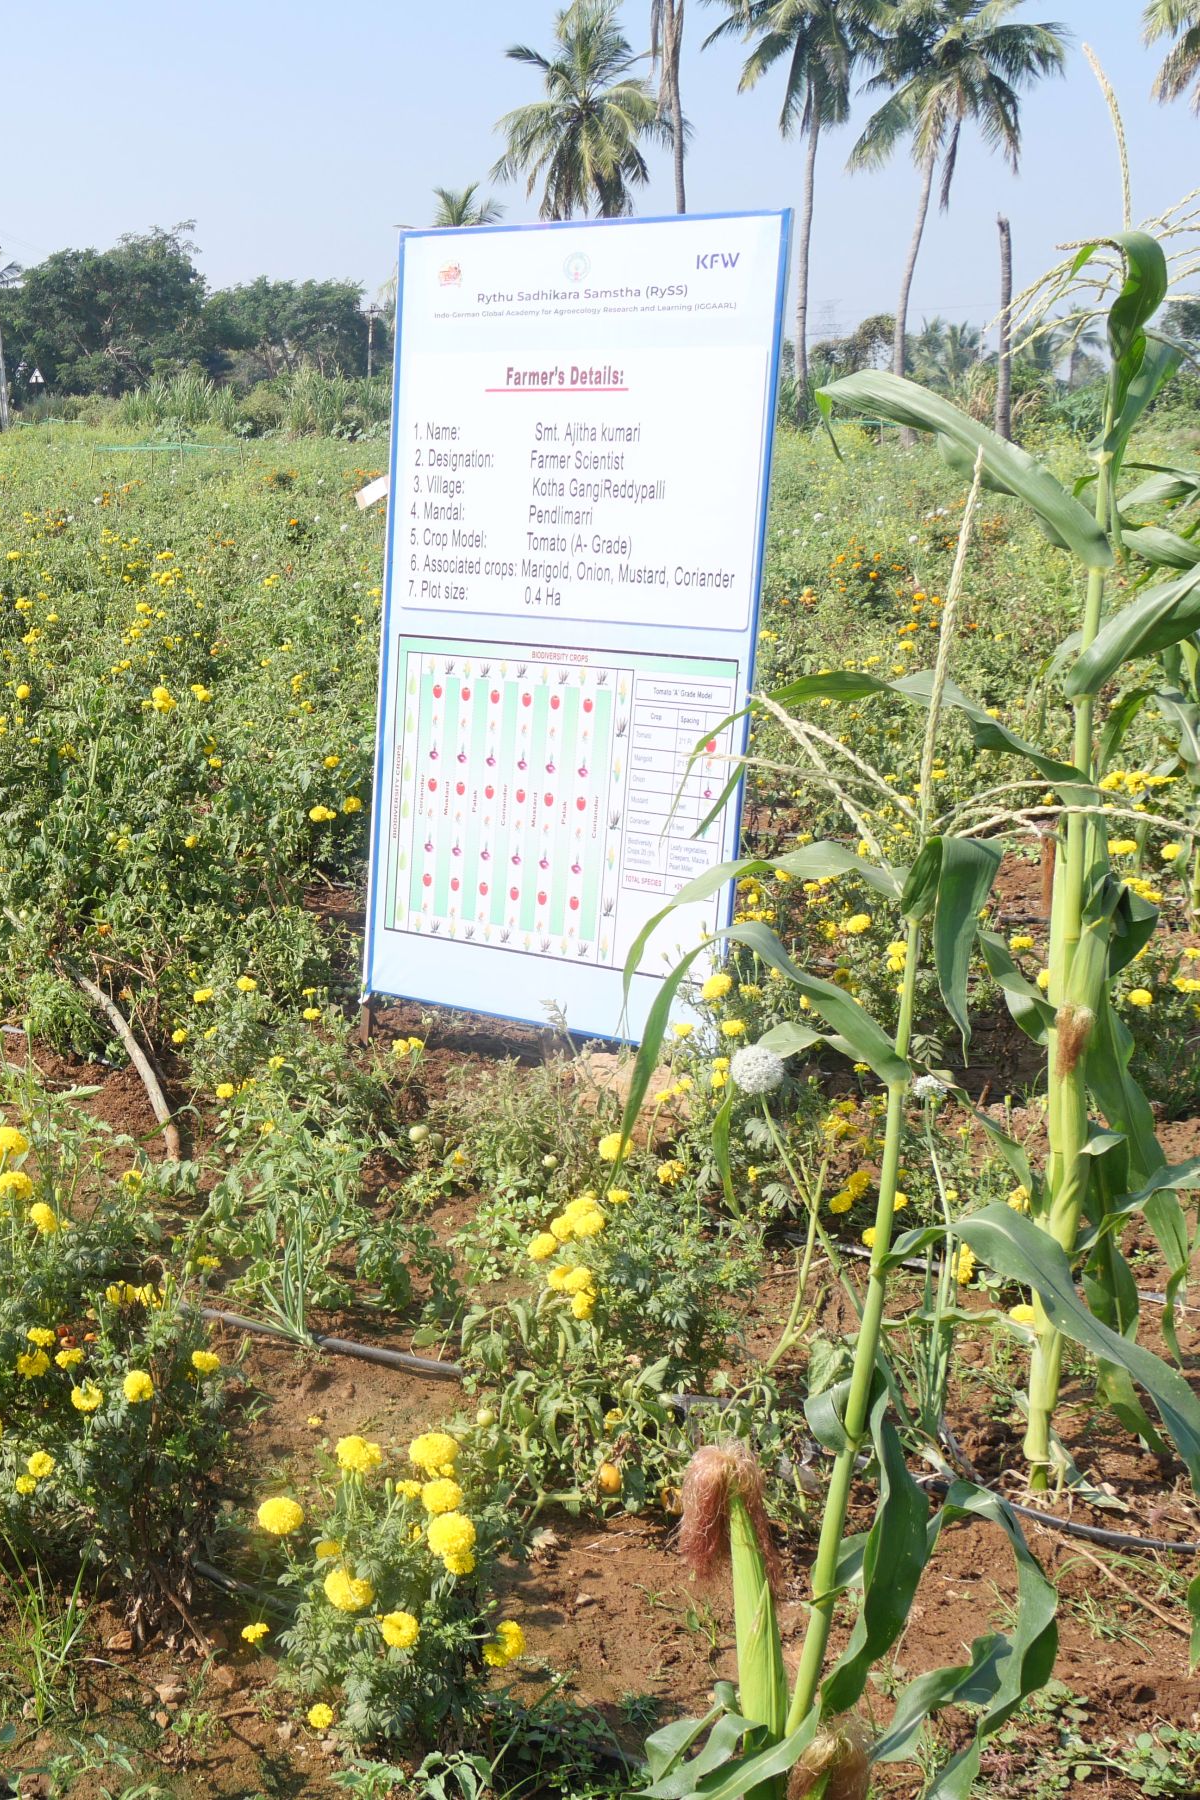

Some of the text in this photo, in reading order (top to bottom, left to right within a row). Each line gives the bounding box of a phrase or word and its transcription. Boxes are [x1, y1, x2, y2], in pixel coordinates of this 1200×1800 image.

[696, 252, 740, 270] KFW
[477, 284, 688, 304] Rythu Sadhikara Samstha (RySS)
[506, 309, 540, 317] Academy
[554, 307, 601, 315] Agroecology
[657, 304, 692, 312] Learning
[506, 366, 624, 386] Farmer's Details:
[414, 422, 640, 446] 1. Name: Smt. Ajitha kumari
[415, 449, 624, 472] 2. Designation: Farmer Scientist
[414, 475, 665, 504] 3. Village: Kotha GangiReddypalli
[410, 502, 593, 525] 4. Mandal: Pendlimarri
[410, 528, 419, 546] 5.
[423, 528, 448, 551] Crop
[452, 529, 487, 549] Model:
[527, 532, 567, 552] Tomato
[592, 534, 632, 560] Grade)
[410, 554, 735, 588] 6. Associated crops: Marigold, Onion, Mustard, Coriander
[409, 580, 561, 606] 7. Plot size: 0.4 Ha
[532, 651, 588, 662] BIODIVERSITY CROPS
[654, 687, 671, 696] Tomato
[651, 712, 699, 725] Crop Spacing
[625, 874, 662, 887] TOTAL SPECIES
